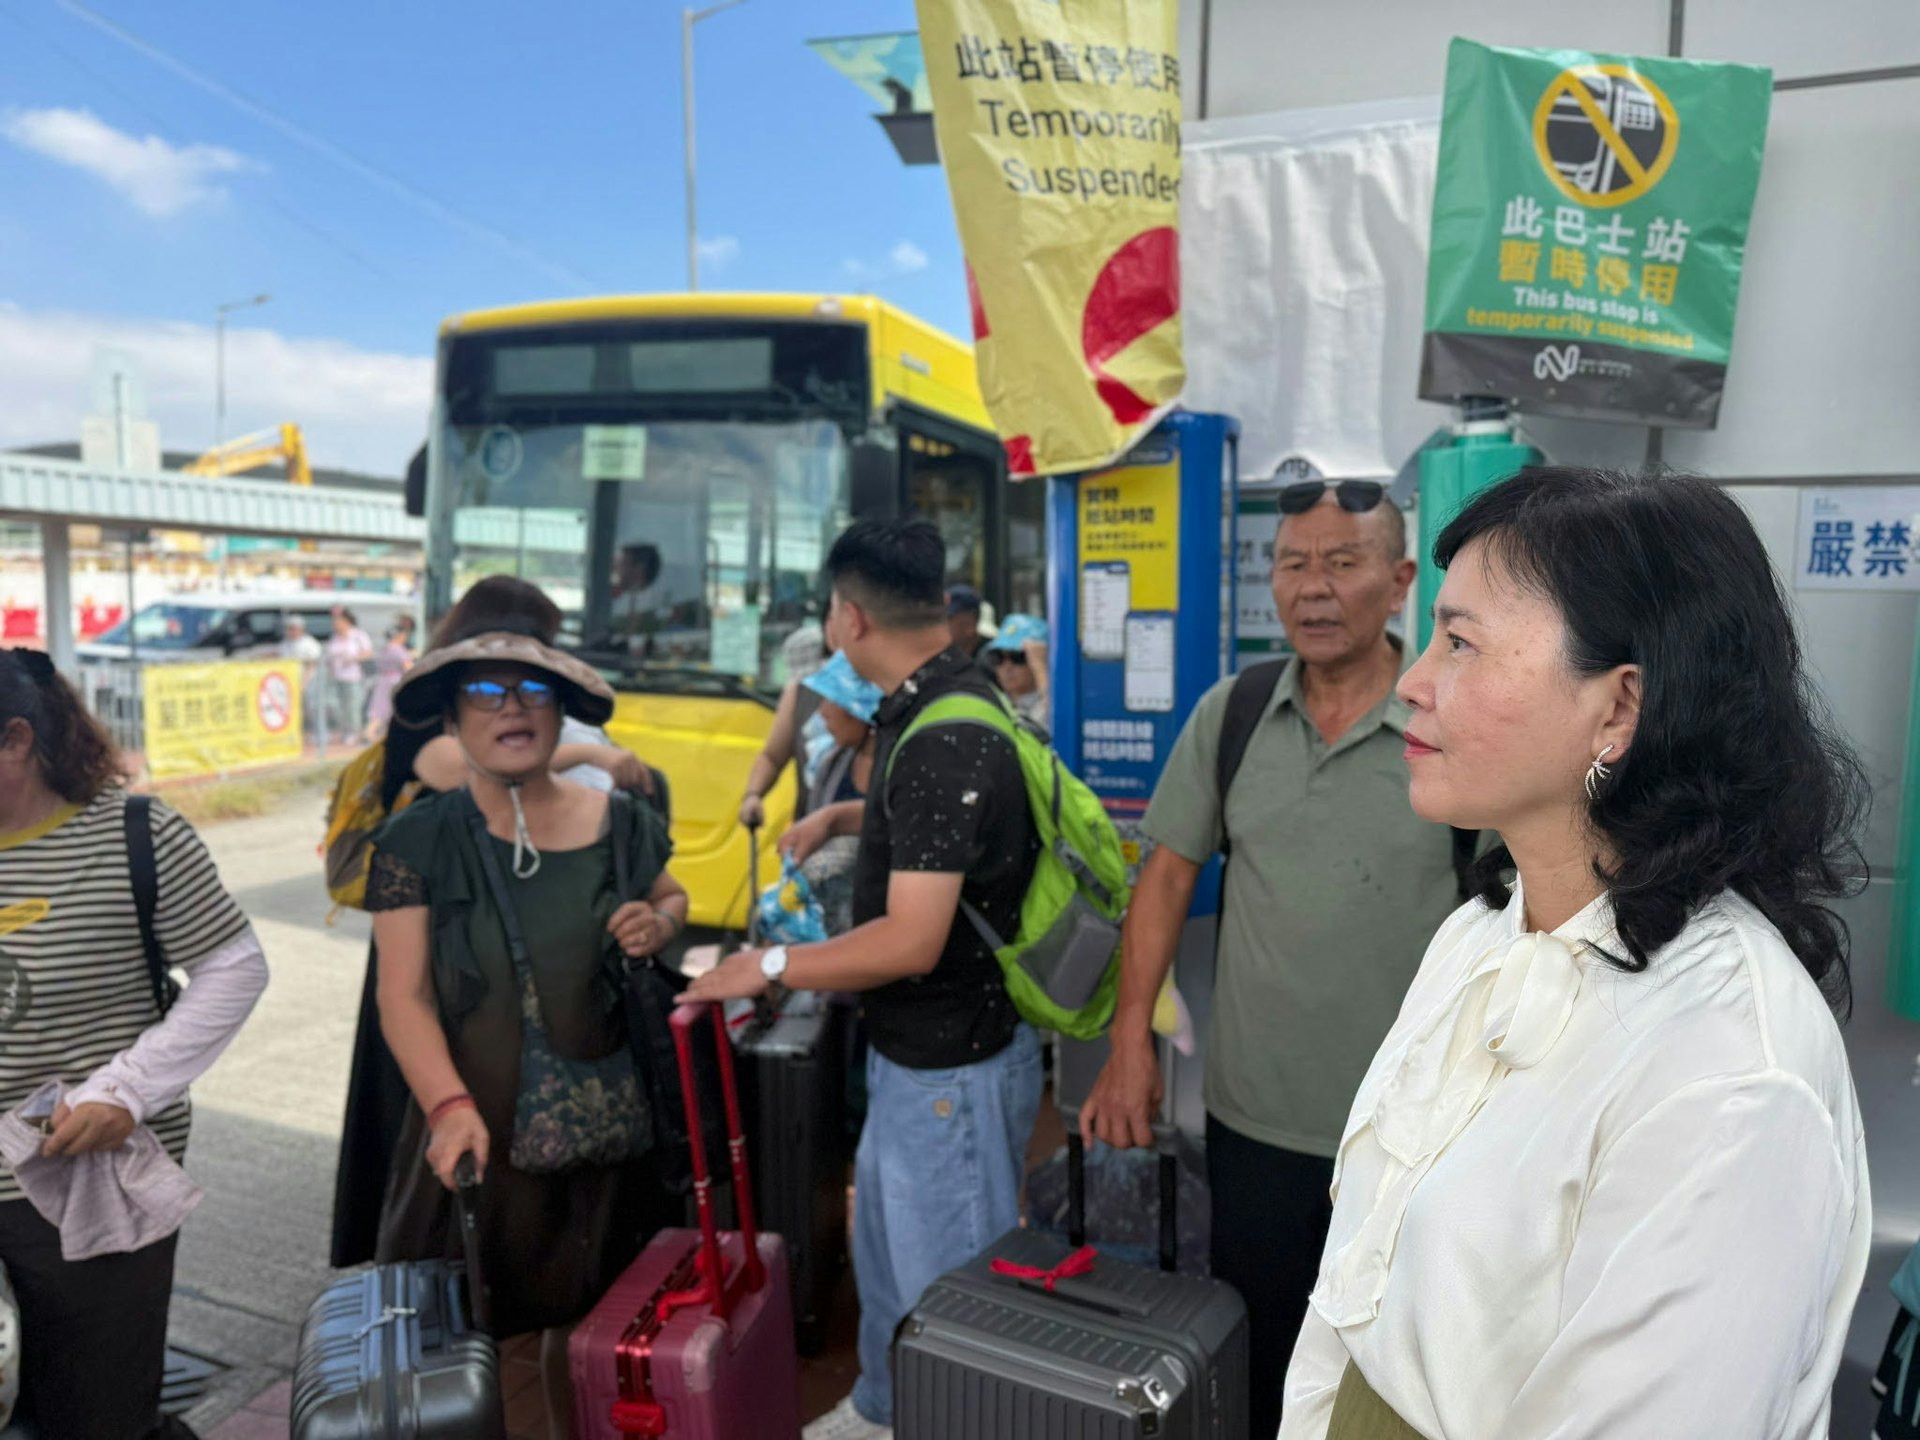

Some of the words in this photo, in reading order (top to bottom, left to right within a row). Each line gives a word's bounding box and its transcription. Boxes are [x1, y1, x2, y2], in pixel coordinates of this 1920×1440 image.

[955, 34, 1180, 94] 此站暫停使用
[1501, 194, 1692, 265] 此巴士站
[1499, 238, 1679, 307] 暫時停用
[1466, 305, 1594, 337] temporarily
[1597, 318, 1695, 352] suspended
[1514, 286, 1559, 309] This
[1563, 290, 1598, 313] bus
[1601, 299, 1640, 324] stop
[1642, 301, 1660, 325] is
[1807, 520, 1911, 577] 嚴禁
